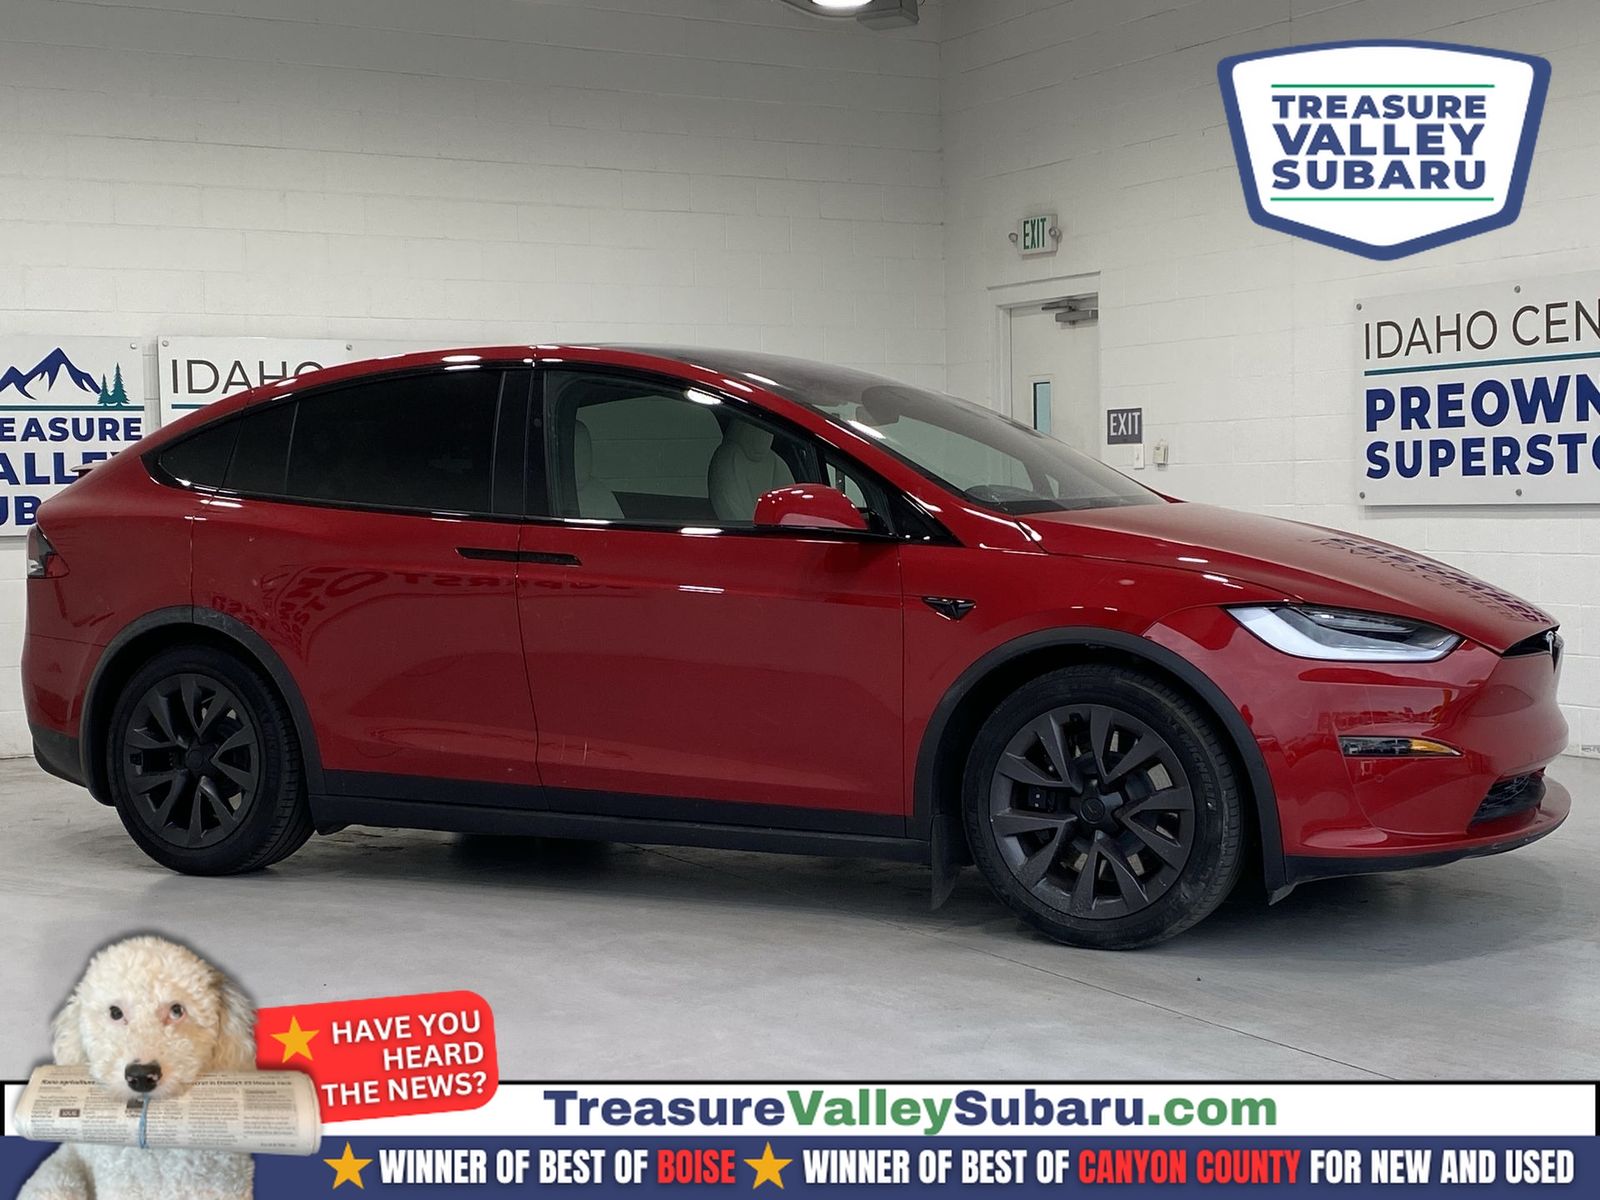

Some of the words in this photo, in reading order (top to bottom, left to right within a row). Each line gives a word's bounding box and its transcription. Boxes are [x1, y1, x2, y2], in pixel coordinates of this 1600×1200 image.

[1023, 218, 1047, 250] EXIT
[1365, 310, 1498, 360] IDAHO
[1512, 299, 1600, 346] CEN
[1110, 412, 1141, 436] EXIT
[1366, 374, 1600, 432] PREOWN
[1366, 433, 1600, 479] SUPERST
